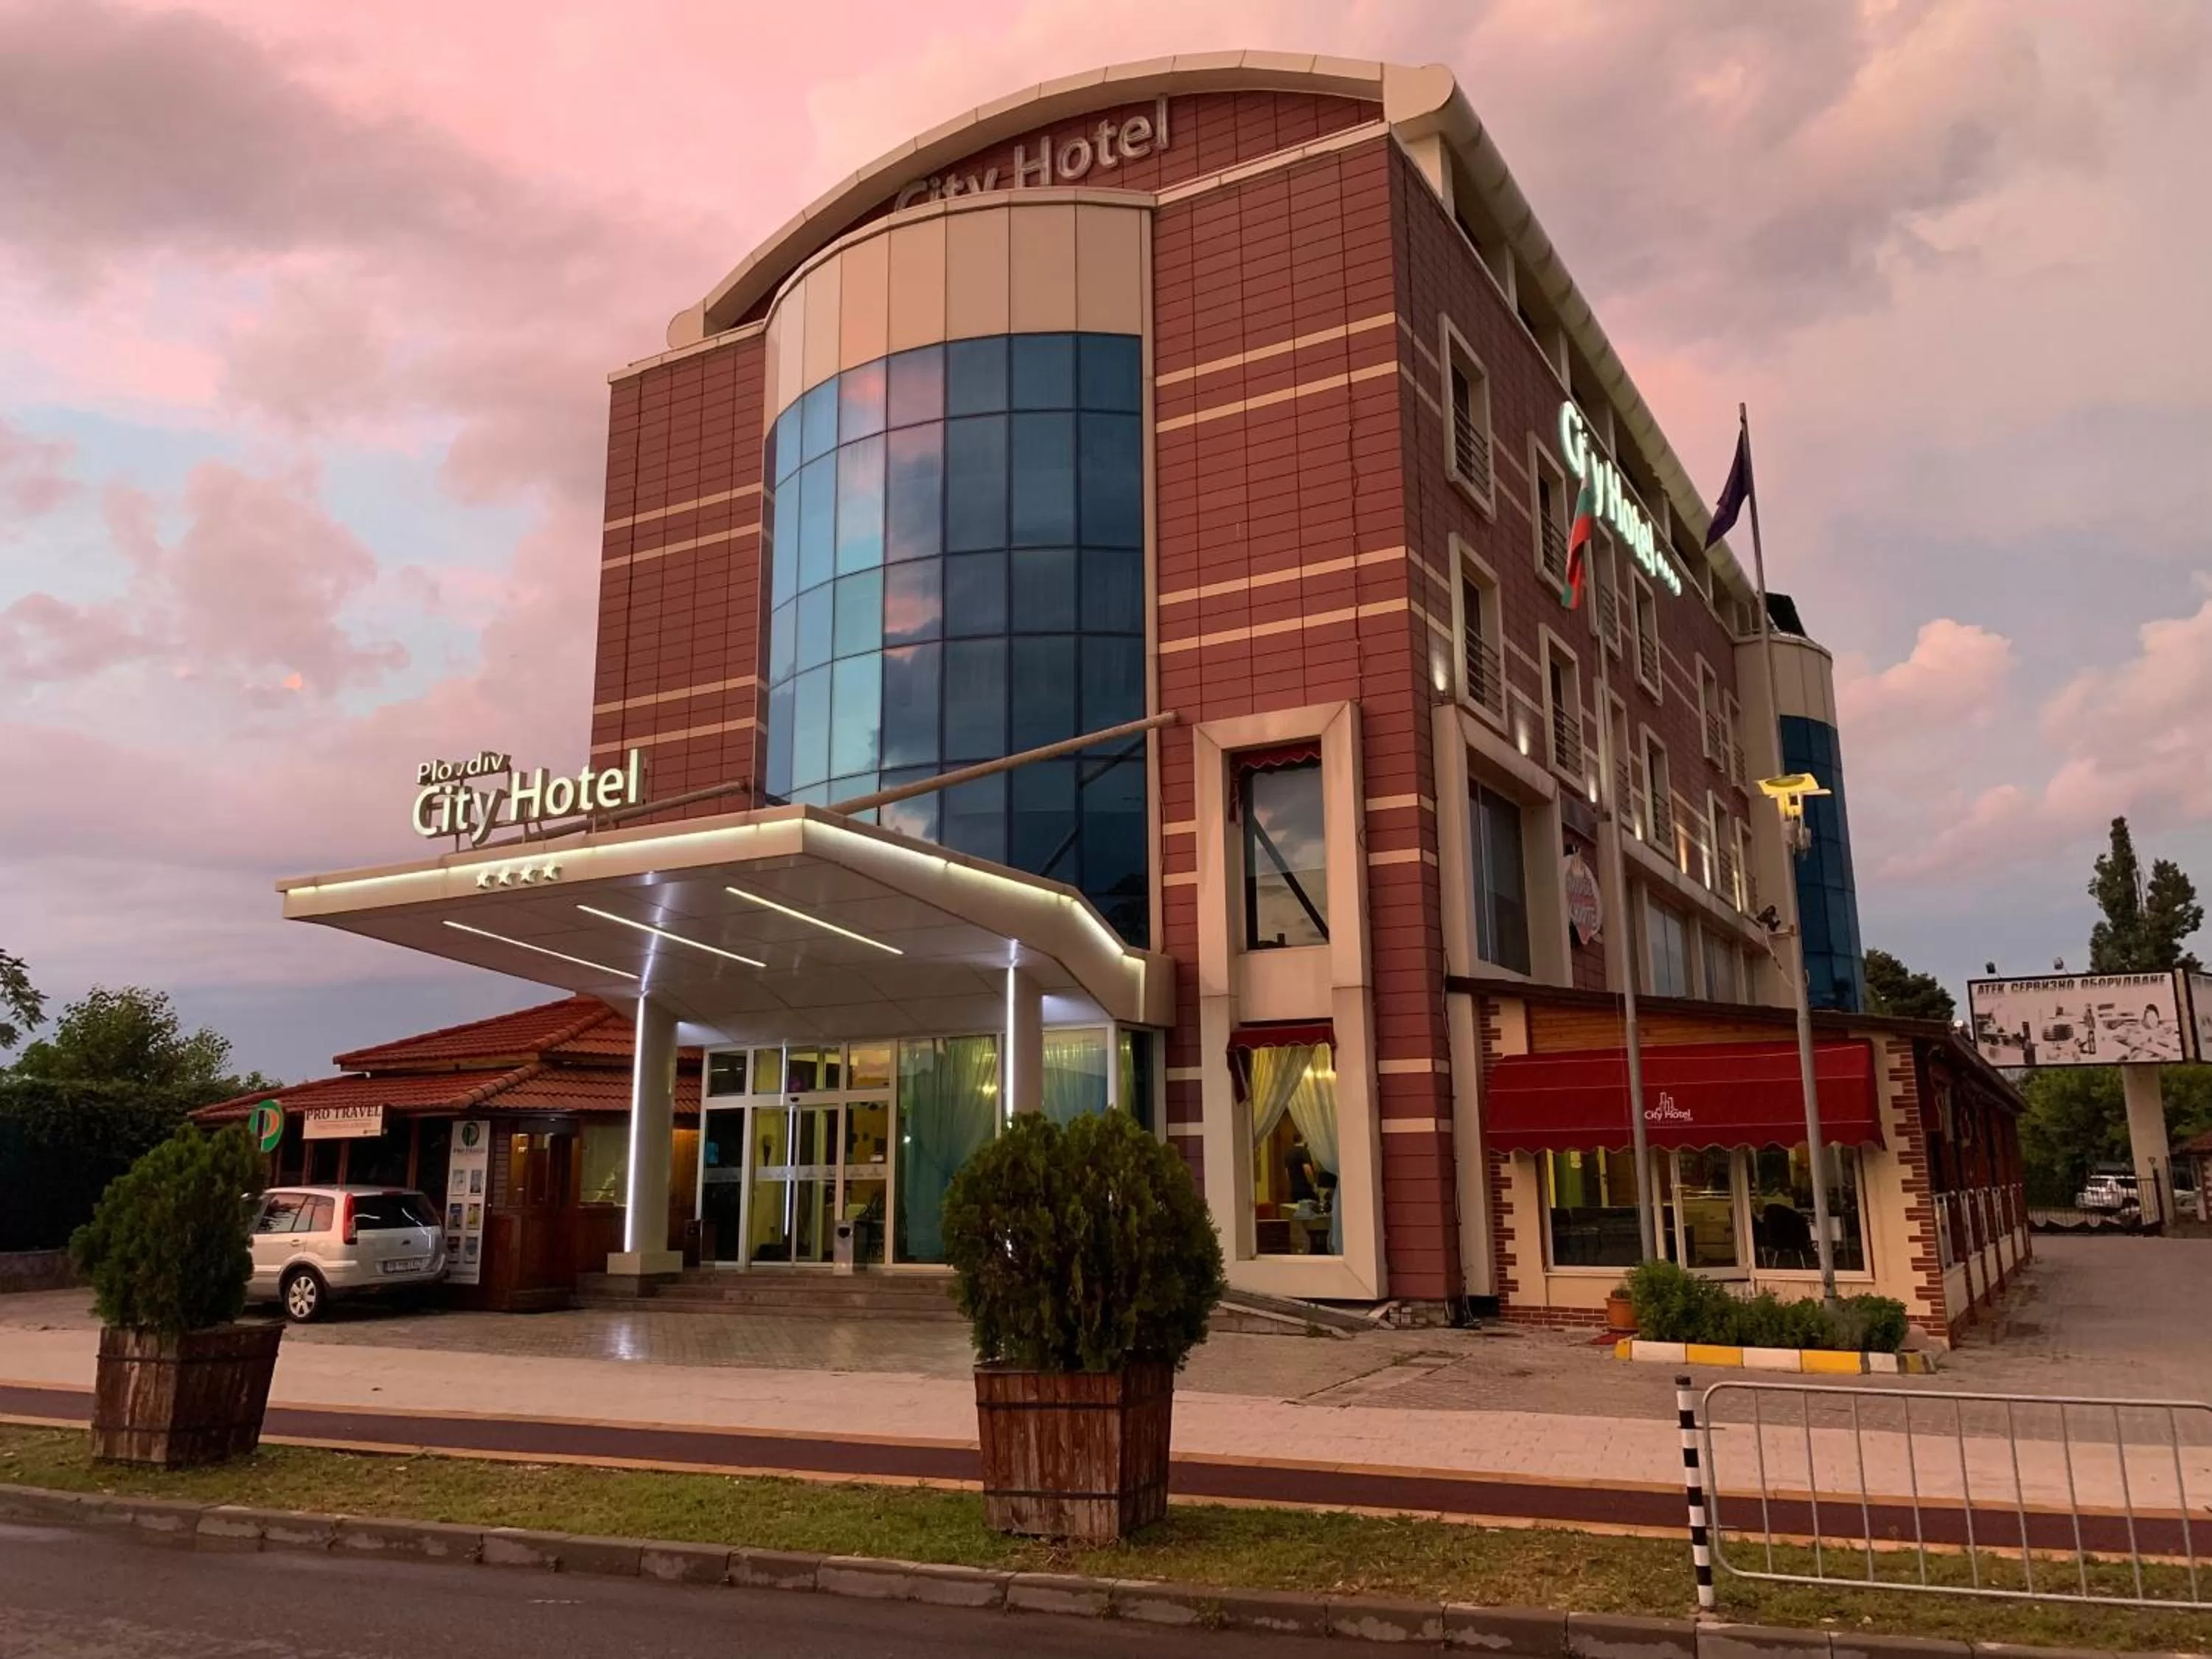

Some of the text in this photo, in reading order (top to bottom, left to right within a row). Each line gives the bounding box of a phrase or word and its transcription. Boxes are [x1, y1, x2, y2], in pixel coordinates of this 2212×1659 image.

[1014, 93, 1169, 188] Hotel
[1559, 400, 1656, 577] Ciy Hotel
[416, 751, 504, 784] Plovdiv
[412, 748, 640, 844] City Hotel
[2011, 978, 2075, 993] СЕРВИЗНО
[2081, 974, 2166, 990] ОБОРУДВАНЕ
[306, 1105, 381, 1120] PRO TRAVEL
[1644, 1108, 1691, 1121] City Hotel
